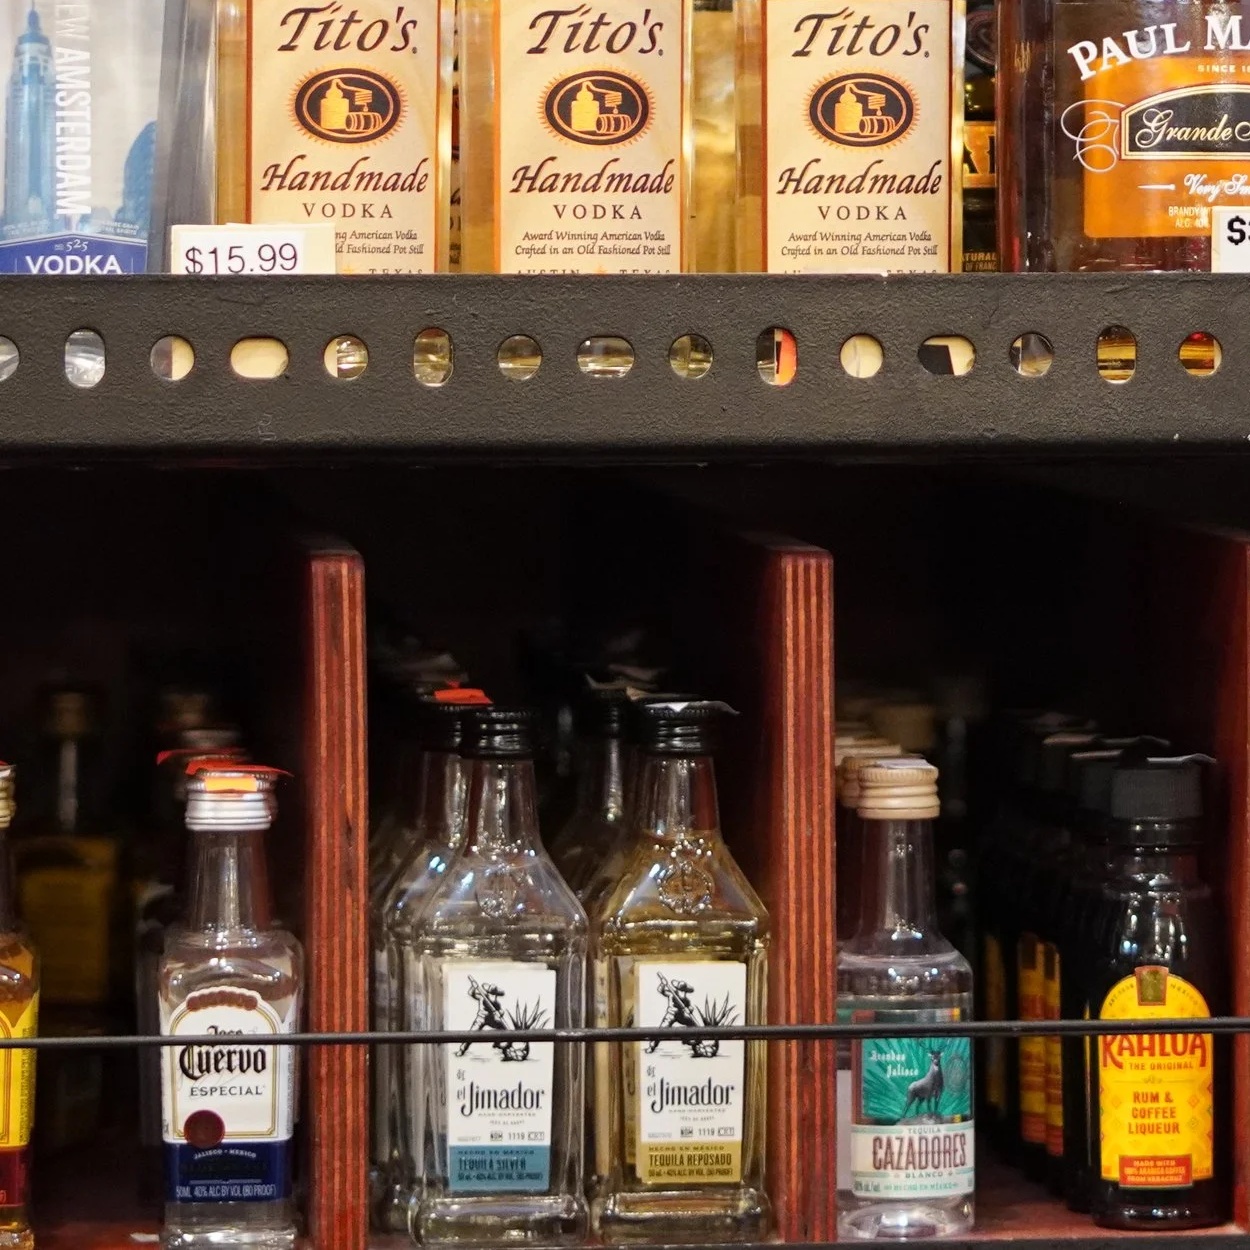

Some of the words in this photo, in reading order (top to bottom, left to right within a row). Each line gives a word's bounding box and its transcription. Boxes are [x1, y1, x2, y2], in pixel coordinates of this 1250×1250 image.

[276, 0, 419, 53] Tito's
[526, 3, 664, 56] Tito's
[791, 6, 930, 57] Tito's
[1066, 21, 1192, 82] PAUL
[1197, 63, 1236, 74] SINCE
[54, 46, 92, 216] AMSTERDAM
[1134, 105, 1236, 149] Grande
[259, 153, 430, 194] Handmade
[508, 156, 676, 195] Handmade
[775, 157, 943, 196] Handmade
[1183, 173, 1221, 203] Very
[302, 202, 394, 219] VODKA
[552, 203, 643, 220] VODKA
[817, 204, 908, 221] VODKA
[349, 229, 394, 240] American
[395, 229, 418, 240] Vodka
[522, 230, 554, 242] Award
[555, 231, 599, 247] Winning
[600, 231, 642, 242] American
[643, 230, 665, 242] Vodka
[787, 230, 818, 242] Award
[819, 231, 862, 247] Winning
[864, 231, 907, 243] American
[909, 231, 932, 243] Vodka
[65, 238, 89, 252] 525
[346, 243, 391, 255] Fashioned
[393, 244, 407, 255] Pot
[408, 244, 424, 255] Still
[515, 244, 547, 259] Crafted
[549, 245, 559, 255] in
[561, 247, 575, 255] an
[577, 244, 595, 256] Old
[597, 244, 641, 255] Fashioned
[642, 245, 656, 255] Pot
[657, 244, 671, 255] Still
[781, 245, 812, 259] Crafted
[813, 245, 824, 255] in
[826, 247, 838, 255] an
[840, 245, 859, 256] Old
[861, 245, 905, 256] Fashioned
[907, 246, 922, 256] Pot
[922, 245, 938, 256] Still
[25, 254, 123, 274] VODKA
[184, 242, 298, 274] $15.99
[178, 1044, 268, 1082] Cuervo
[1128, 1061, 1146, 1071] THE
[1149, 1061, 1195, 1071] ORIGINAL
[189, 1085, 263, 1097] ESPECIAL
[456, 1085, 466, 1100] el
[646, 1081, 656, 1097] el
[650, 1076, 735, 1114] Jimador
[1133, 1090, 1160, 1104] RUM
[1164, 1091, 1174, 1104] &
[460, 1080, 545, 1118] Jimador
[1131, 1106, 1177, 1119] COFFEE
[908, 1127, 942, 1135] TEQUILA
[1127, 1121, 1180, 1135] LIQUEUR
[649, 1153, 685, 1166] TEQUILA
[687, 1153, 732, 1166] REPOSADO
[871, 1133, 967, 1171] CAZADORES
[905, 1171, 944, 1179] BLANCO
